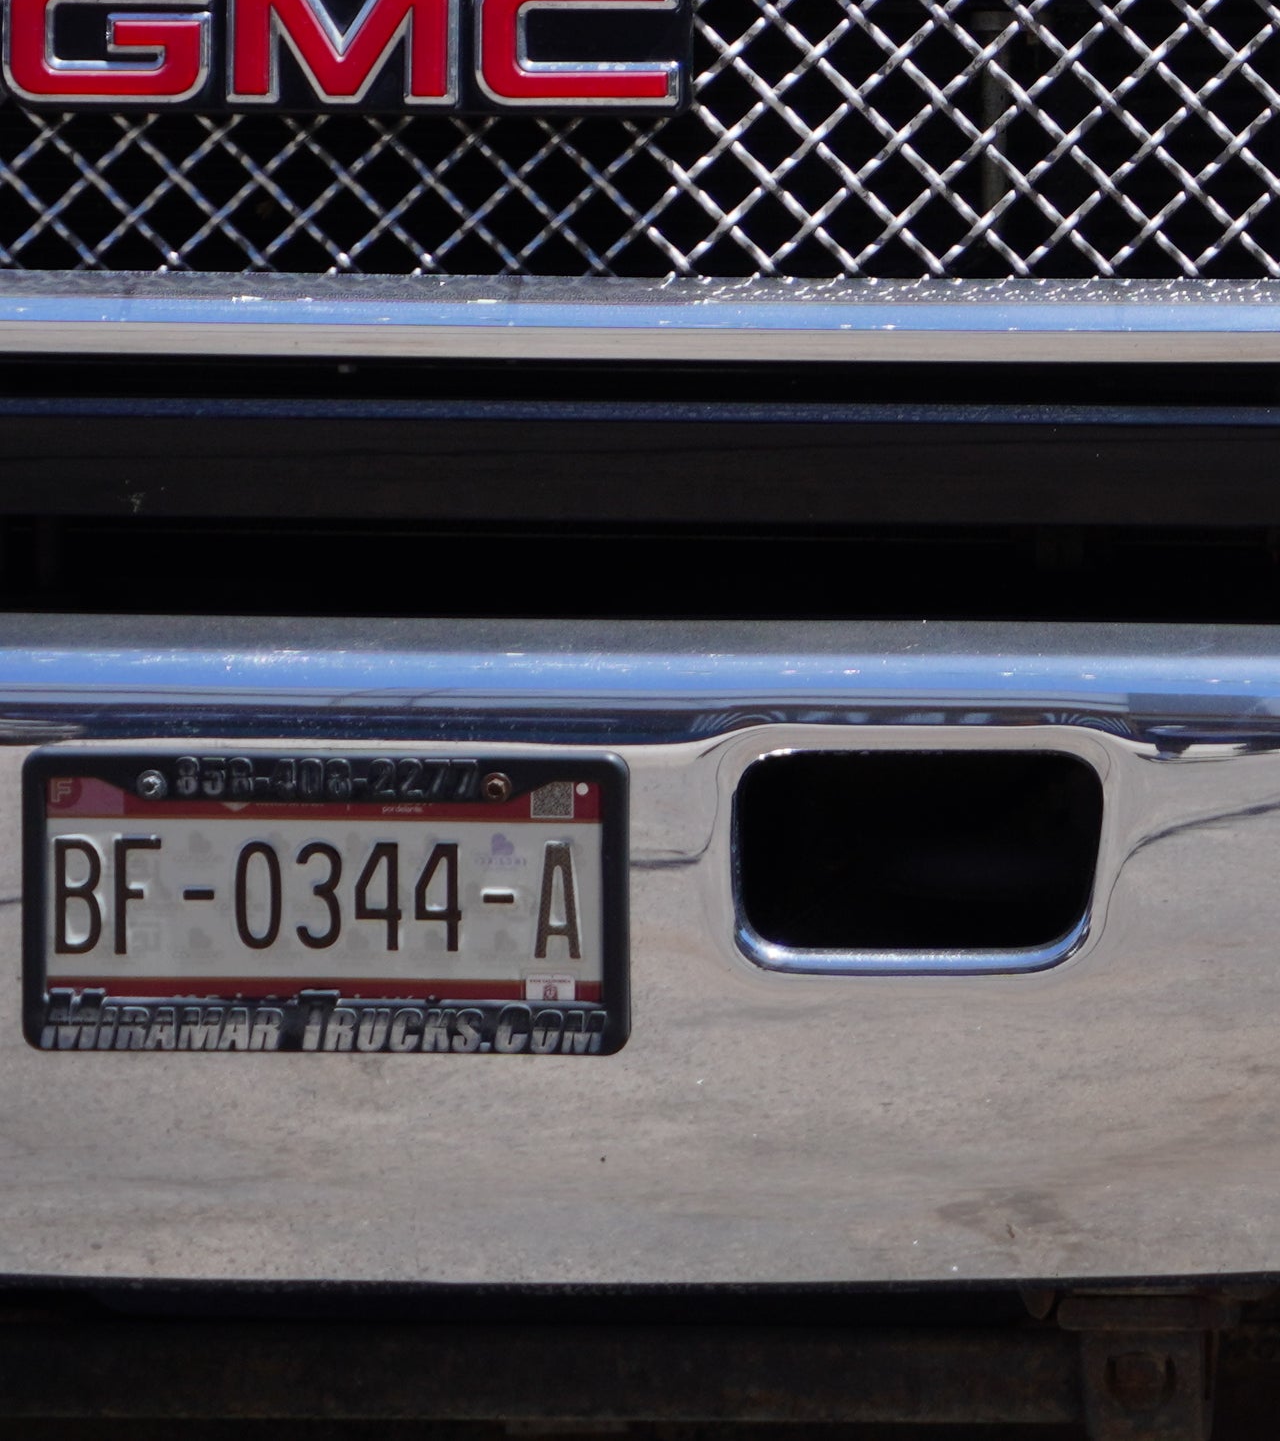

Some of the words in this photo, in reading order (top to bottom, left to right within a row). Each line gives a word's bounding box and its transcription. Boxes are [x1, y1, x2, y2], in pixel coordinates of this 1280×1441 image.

[174, 755, 480, 798] 858-408-2277
[53, 835, 581, 959] BF-0344-A
[40, 986, 285, 1051] MIRAMAR
[300, 988, 608, 1054] TRUCKS.COM
